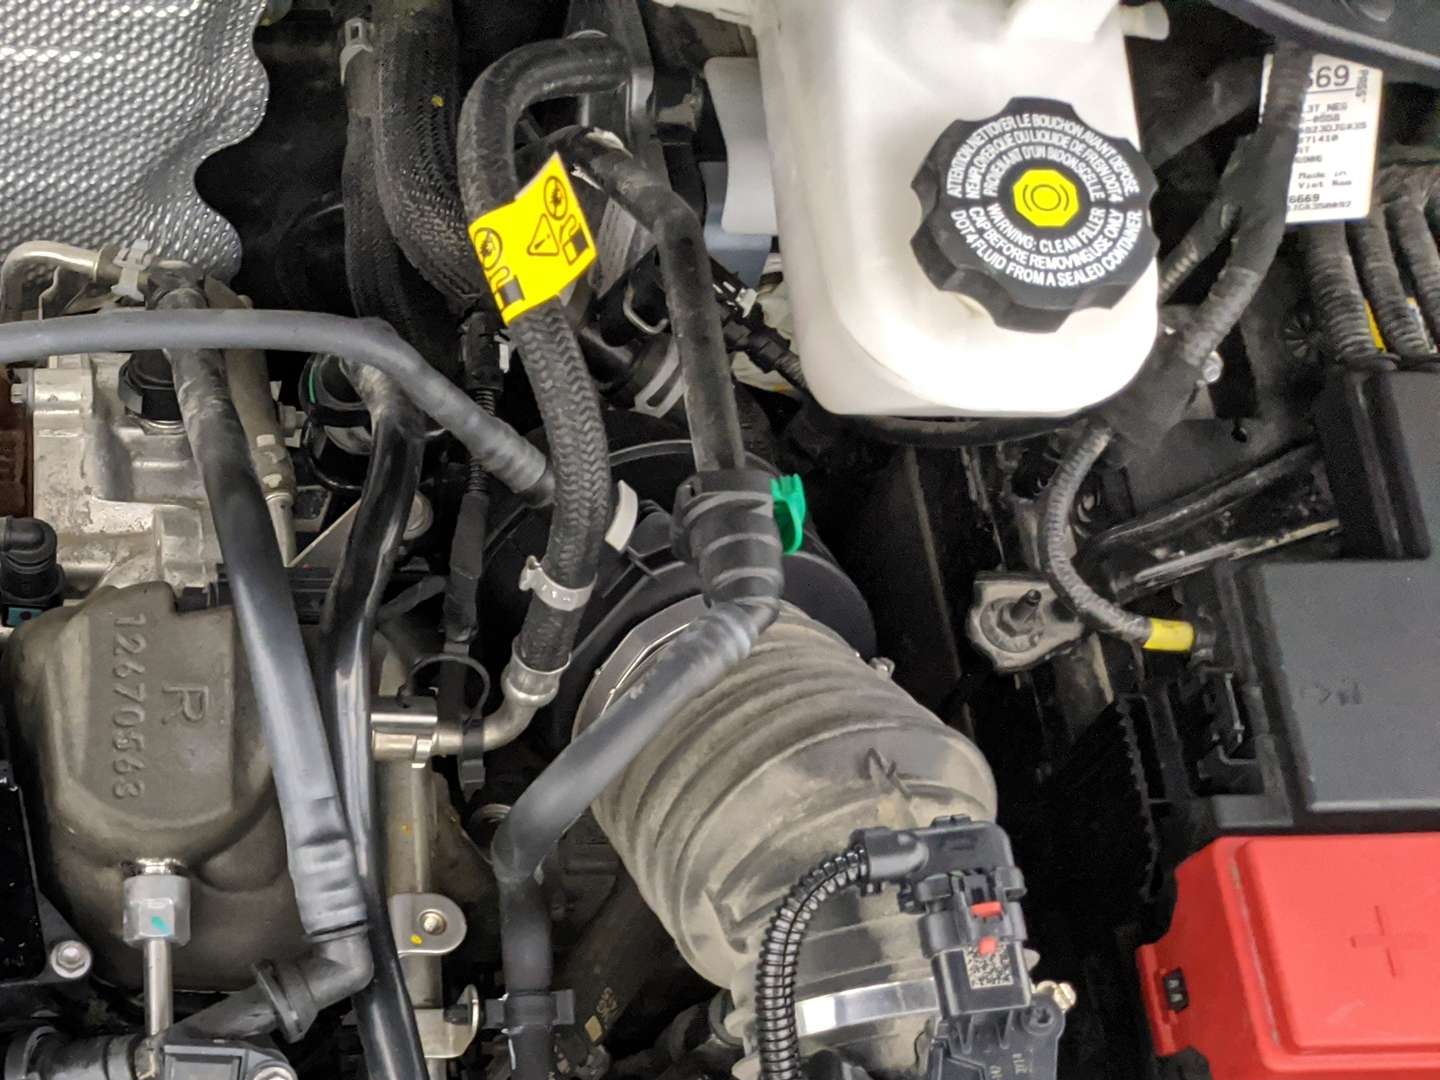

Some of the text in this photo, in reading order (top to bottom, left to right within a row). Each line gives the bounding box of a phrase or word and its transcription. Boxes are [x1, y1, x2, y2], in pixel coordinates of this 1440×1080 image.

[1310, 64, 1350, 88] 69
[1013, 130, 1030, 143] DU
[1030, 129, 1071, 149] LIQUIDE
[1068, 139, 1087, 156] DE
[1016, 113, 1031, 128] LE
[1032, 113, 1085, 137] BOUCHON
[1081, 130, 1118, 158] AVANT
[969, 206, 992, 230] CAP
[982, 228, 1030, 265] BEFORE
[1103, 208, 1124, 239] ONLY
[1039, 235, 1082, 254] CLEAN
[1077, 207, 1106, 244] FILLER
[970, 239, 1007, 270] FLUID
[1005, 261, 1045, 285] FROM
[1046, 271, 1056, 287] A
[1057, 262, 1106, 287] SEALED
